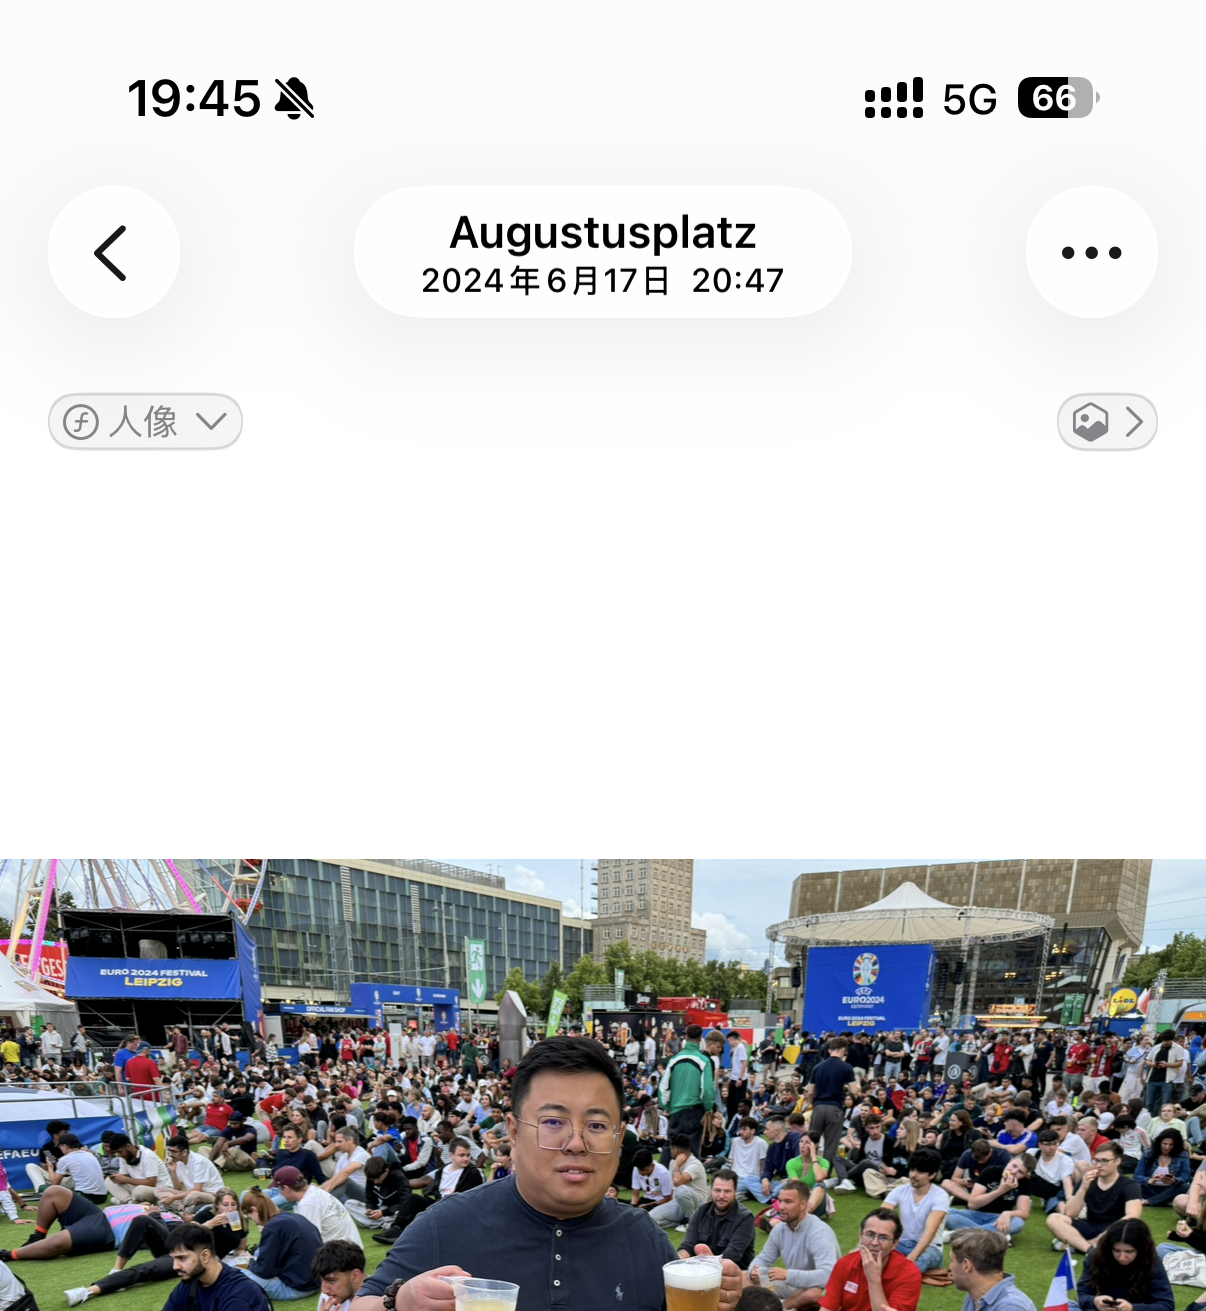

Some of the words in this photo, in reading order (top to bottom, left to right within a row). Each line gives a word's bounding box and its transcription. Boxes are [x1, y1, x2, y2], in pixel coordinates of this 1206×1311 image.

[100, 968, 129, 976] EURO
[130, 969, 159, 977] 2024
[160, 969, 208, 977] FESTIVAL
[124, 977, 183, 987] LEIPZIG
[855, 986, 873, 996] UEFA
